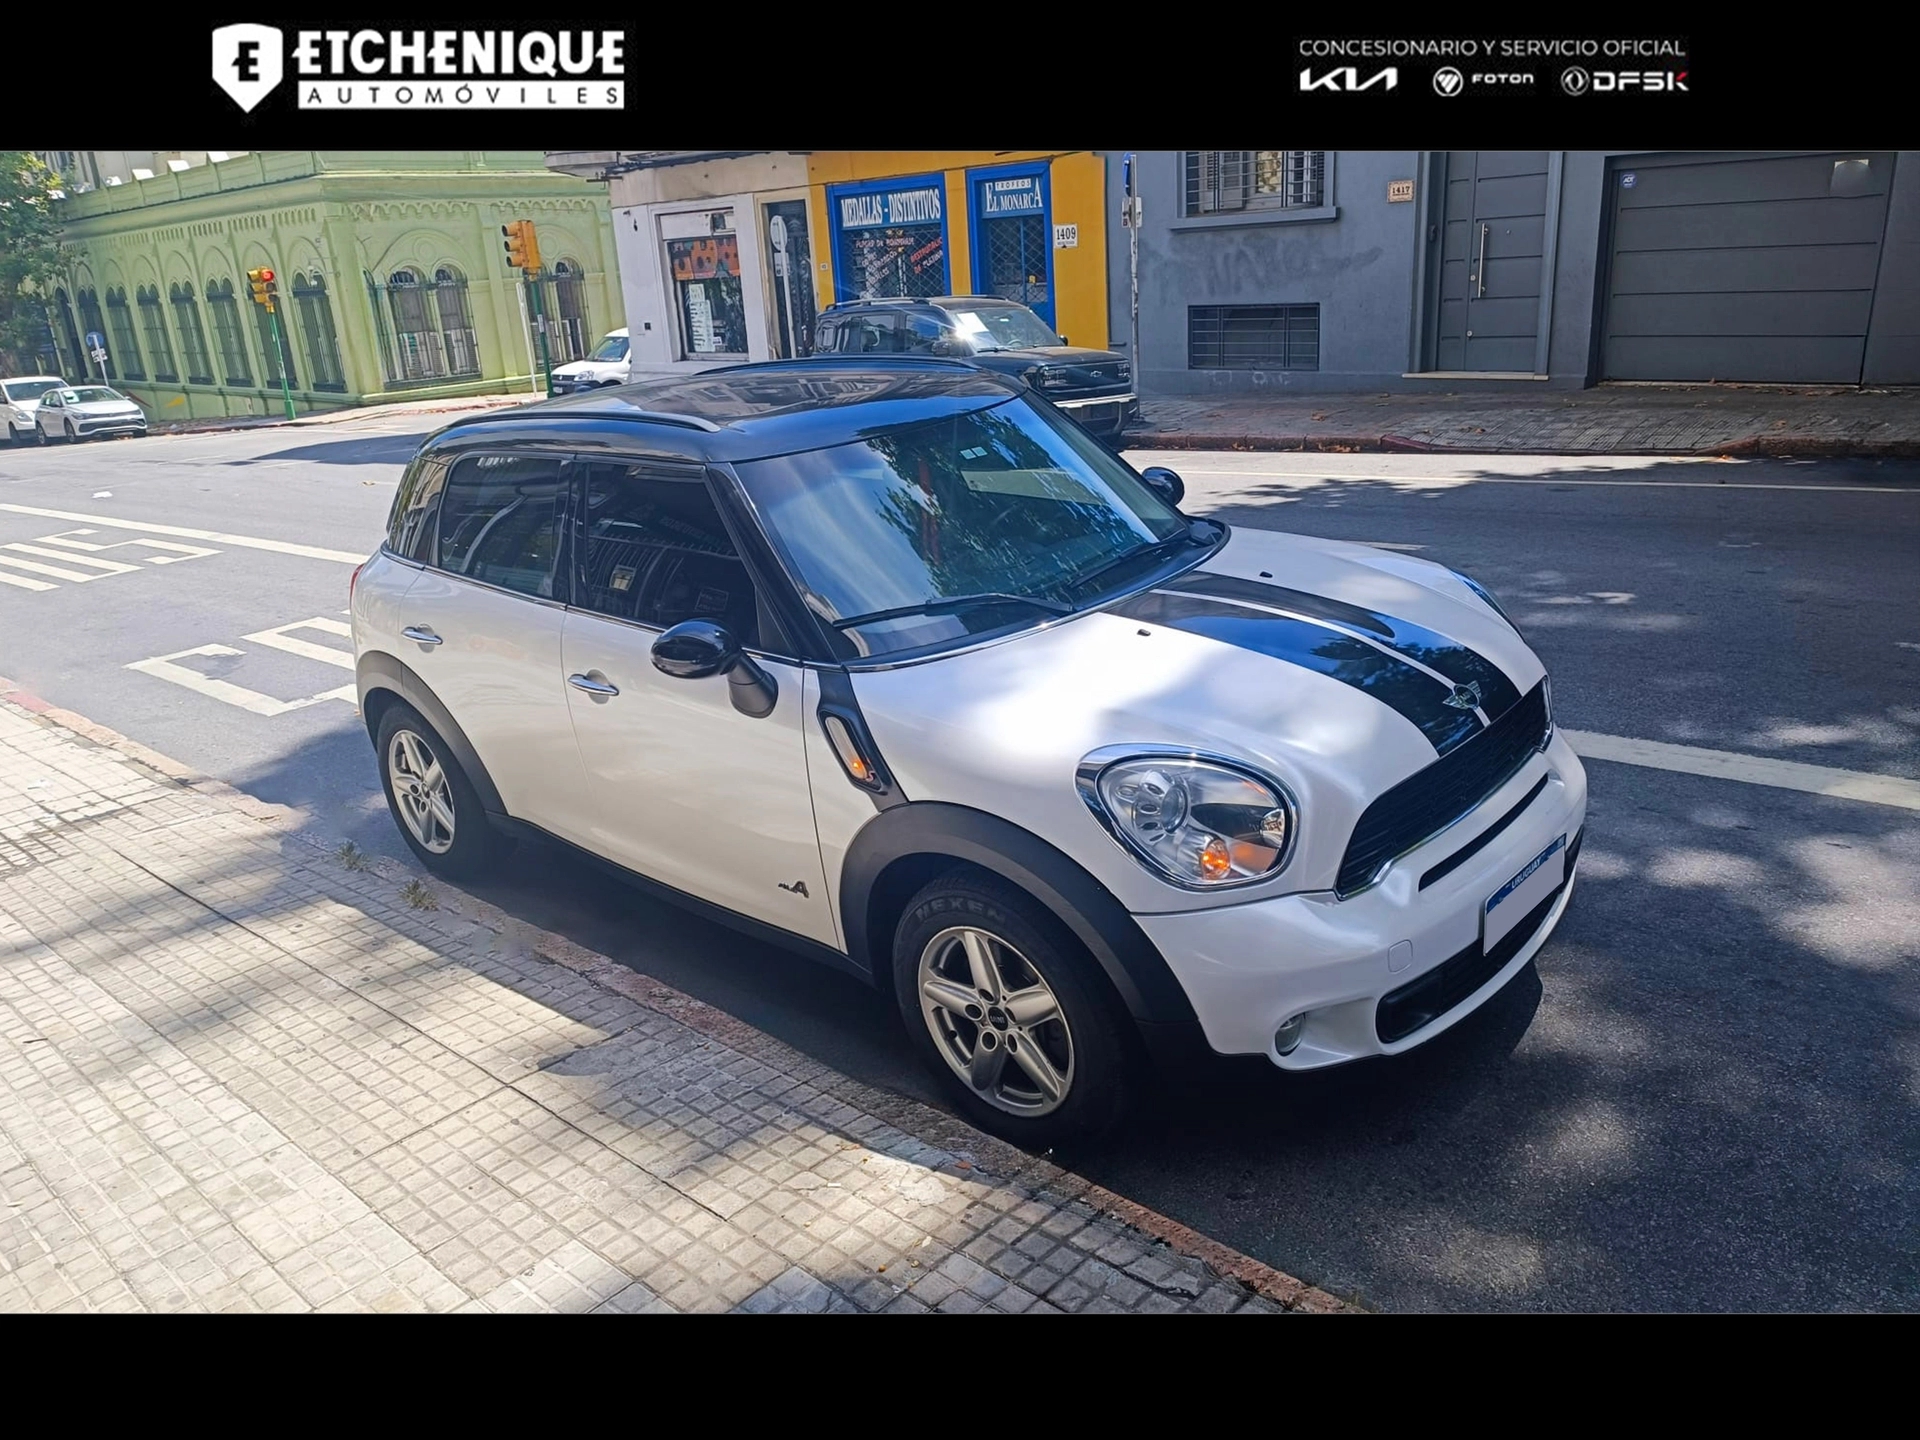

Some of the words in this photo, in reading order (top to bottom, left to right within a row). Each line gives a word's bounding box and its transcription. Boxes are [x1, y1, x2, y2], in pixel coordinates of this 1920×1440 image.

[996, 180, 1031, 190] TROFEOS
[1000, 177, 1044, 211] MONARCA
[1392, 185, 1411, 194] 1417
[841, 195, 883, 228] MEDALLAS
[888, 188, 941, 223] DISTINTIVOS
[1056, 226, 1076, 240] 1409
[1511, 857, 1542, 889] URUGUAY
